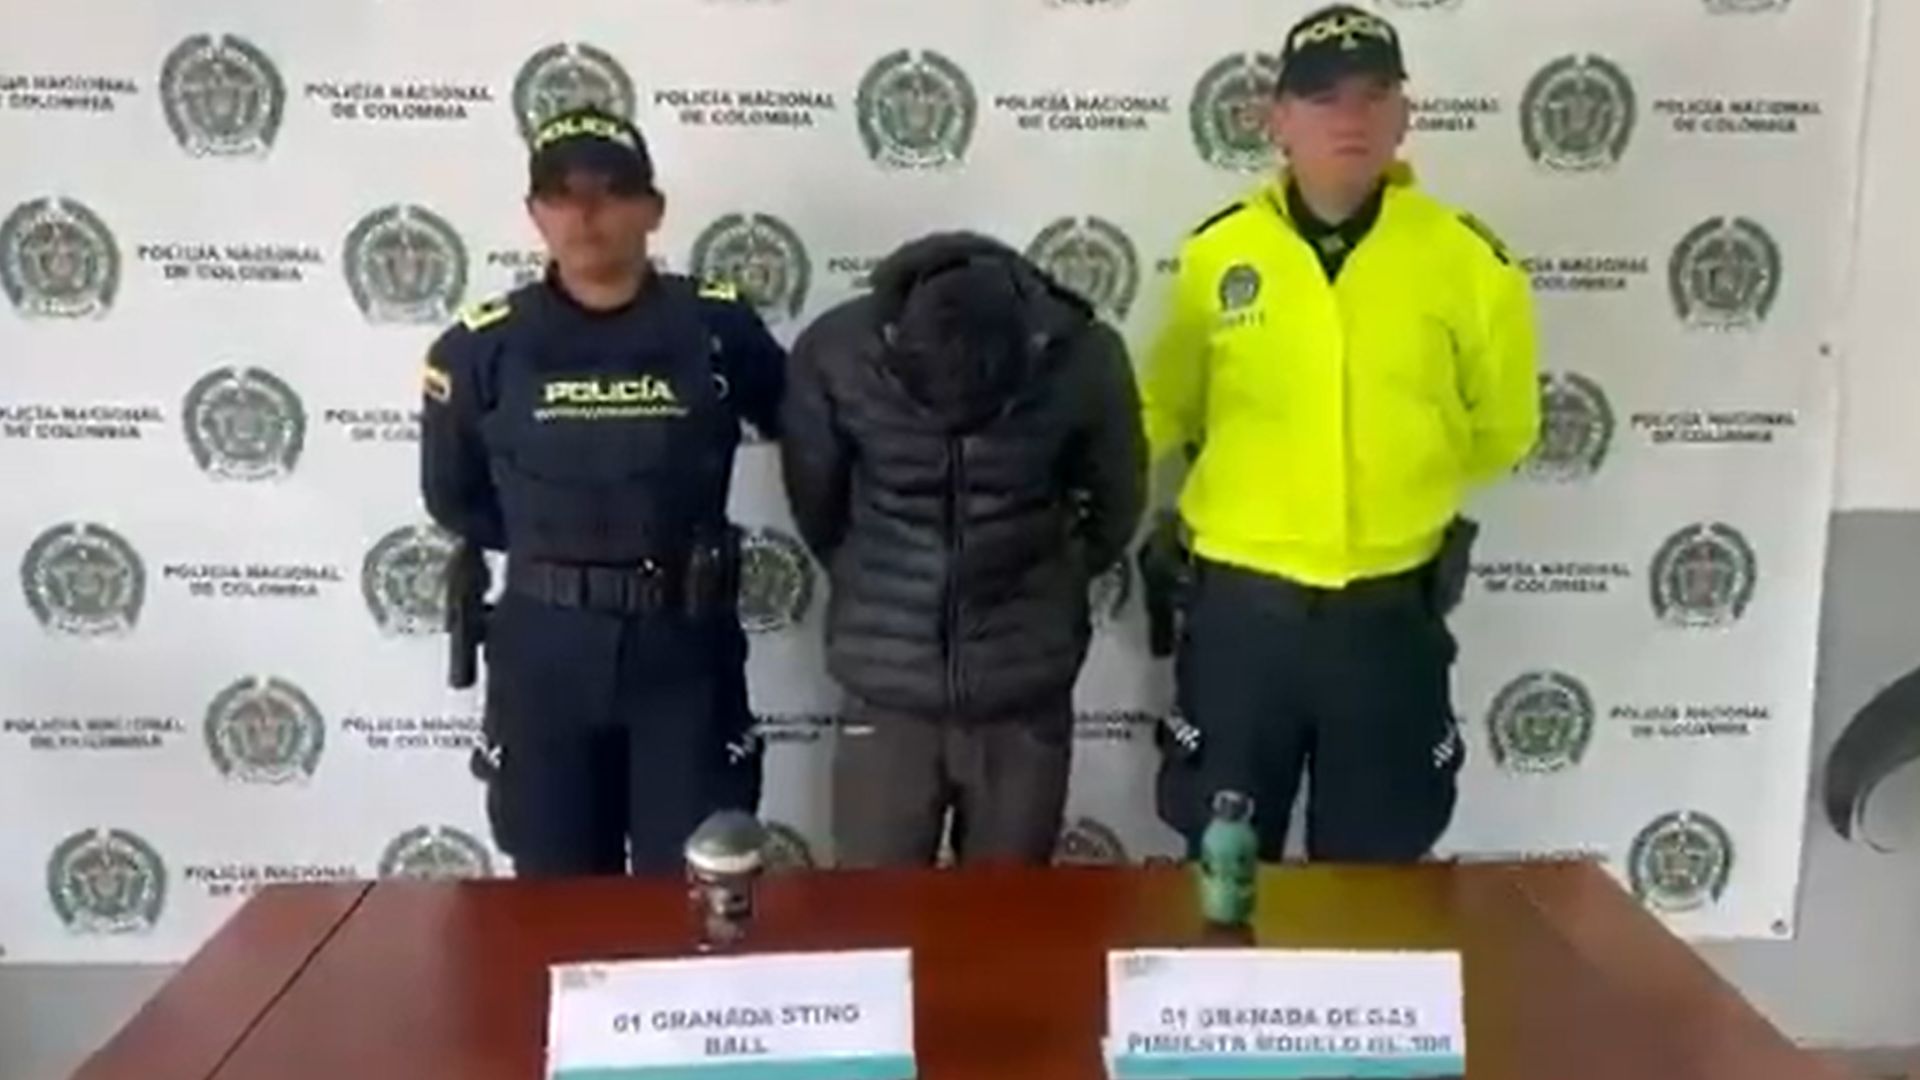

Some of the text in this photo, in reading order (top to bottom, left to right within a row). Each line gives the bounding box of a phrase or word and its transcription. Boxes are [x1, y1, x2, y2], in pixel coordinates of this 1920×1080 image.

[390, 84, 493, 102] NACIONAL
[738, 90, 835, 109] NACIONAL
[363, 103, 467, 119] COLOMBIA
[1075, 96, 1169, 113] NACIONAL
[711, 110, 813, 126] COLOMBIA
[1048, 114, 1147, 130] COLOMBIA
[546, 375, 676, 402] POLICÍA
[613, 1003, 861, 1033] 01 GRANADA STING
[1161, 1007, 1418, 1029] 01 GRANADA DE GAS
[705, 1036, 770, 1056] BALL
[1128, 1033, 1247, 1052] PIMIENTA
